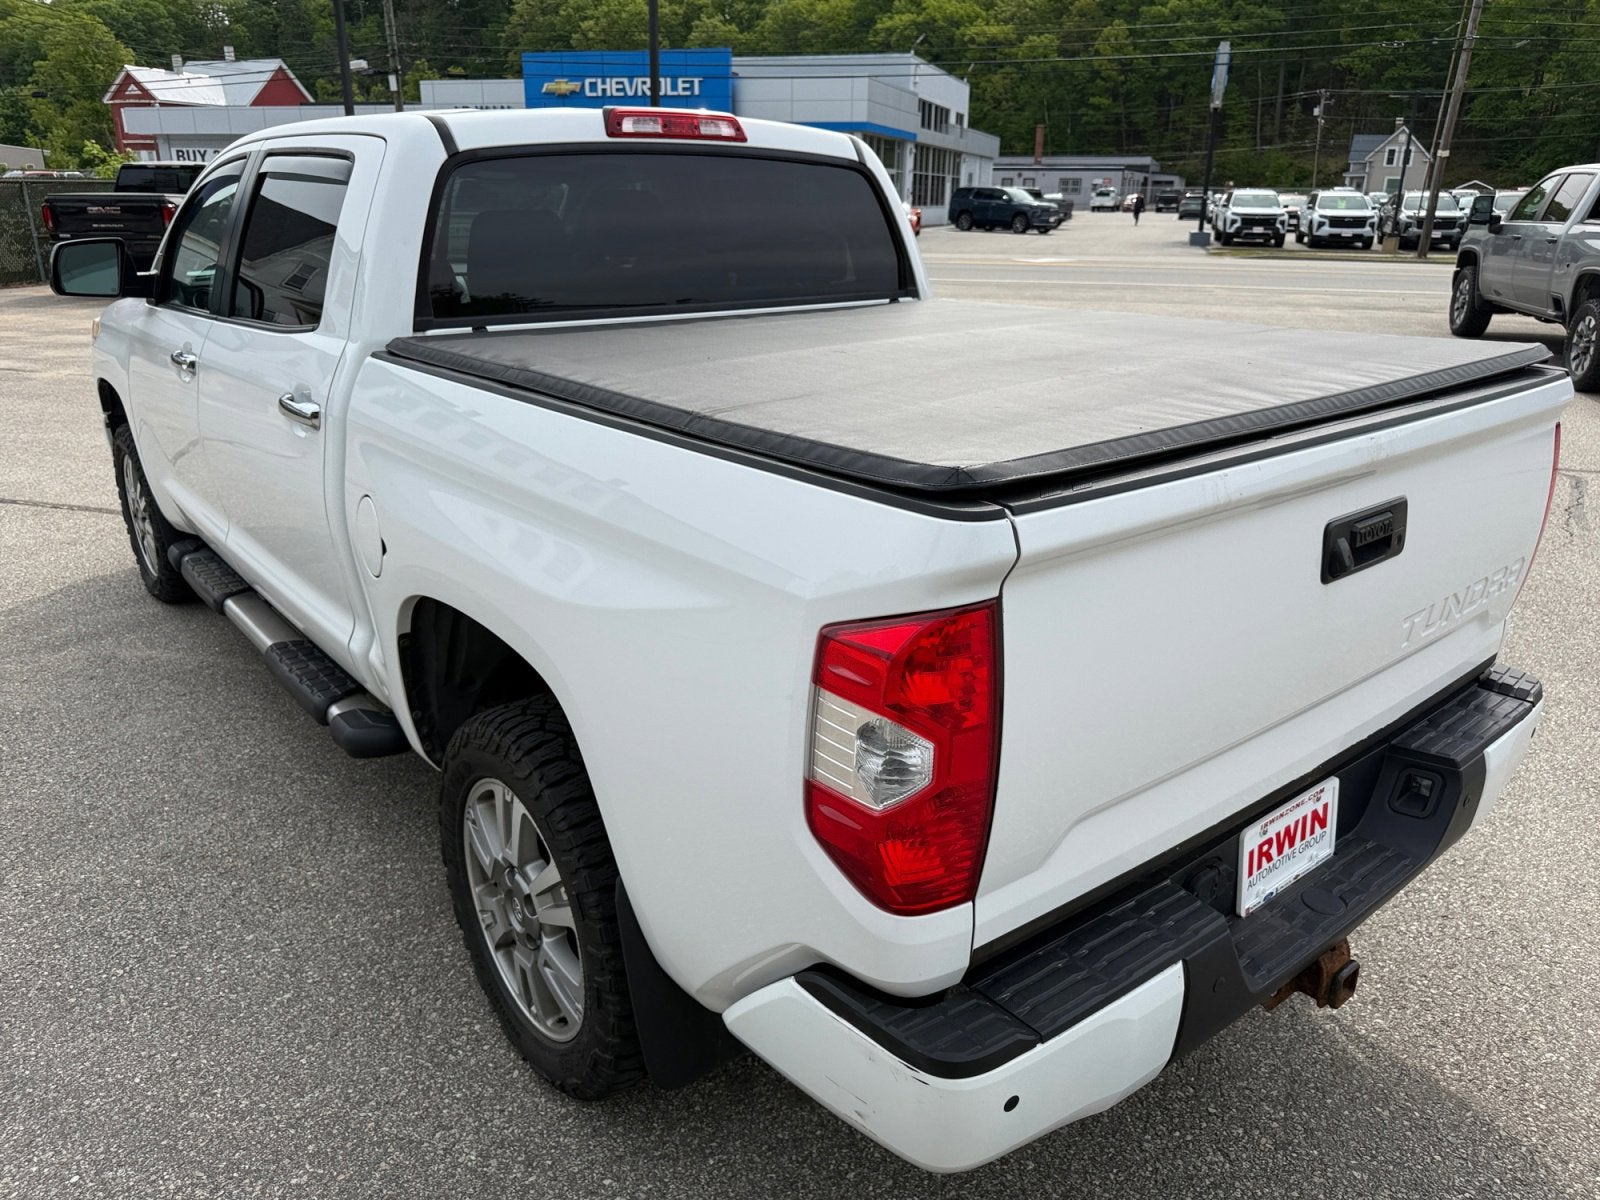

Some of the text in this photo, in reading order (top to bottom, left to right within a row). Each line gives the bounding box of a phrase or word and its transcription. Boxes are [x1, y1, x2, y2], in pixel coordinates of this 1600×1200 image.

[175, 149, 207, 162] BUY
[1358, 519, 1394, 545] TOYOTA
[1401, 556, 1525, 648] TUNDRA
[1260, 787, 1325, 831] IRWINZONE.COM
[1246, 848, 1297, 892] AUTOMOTIVE
[1298, 830, 1327, 854] GROUP
[1247, 801, 1329, 879] IRWIN
